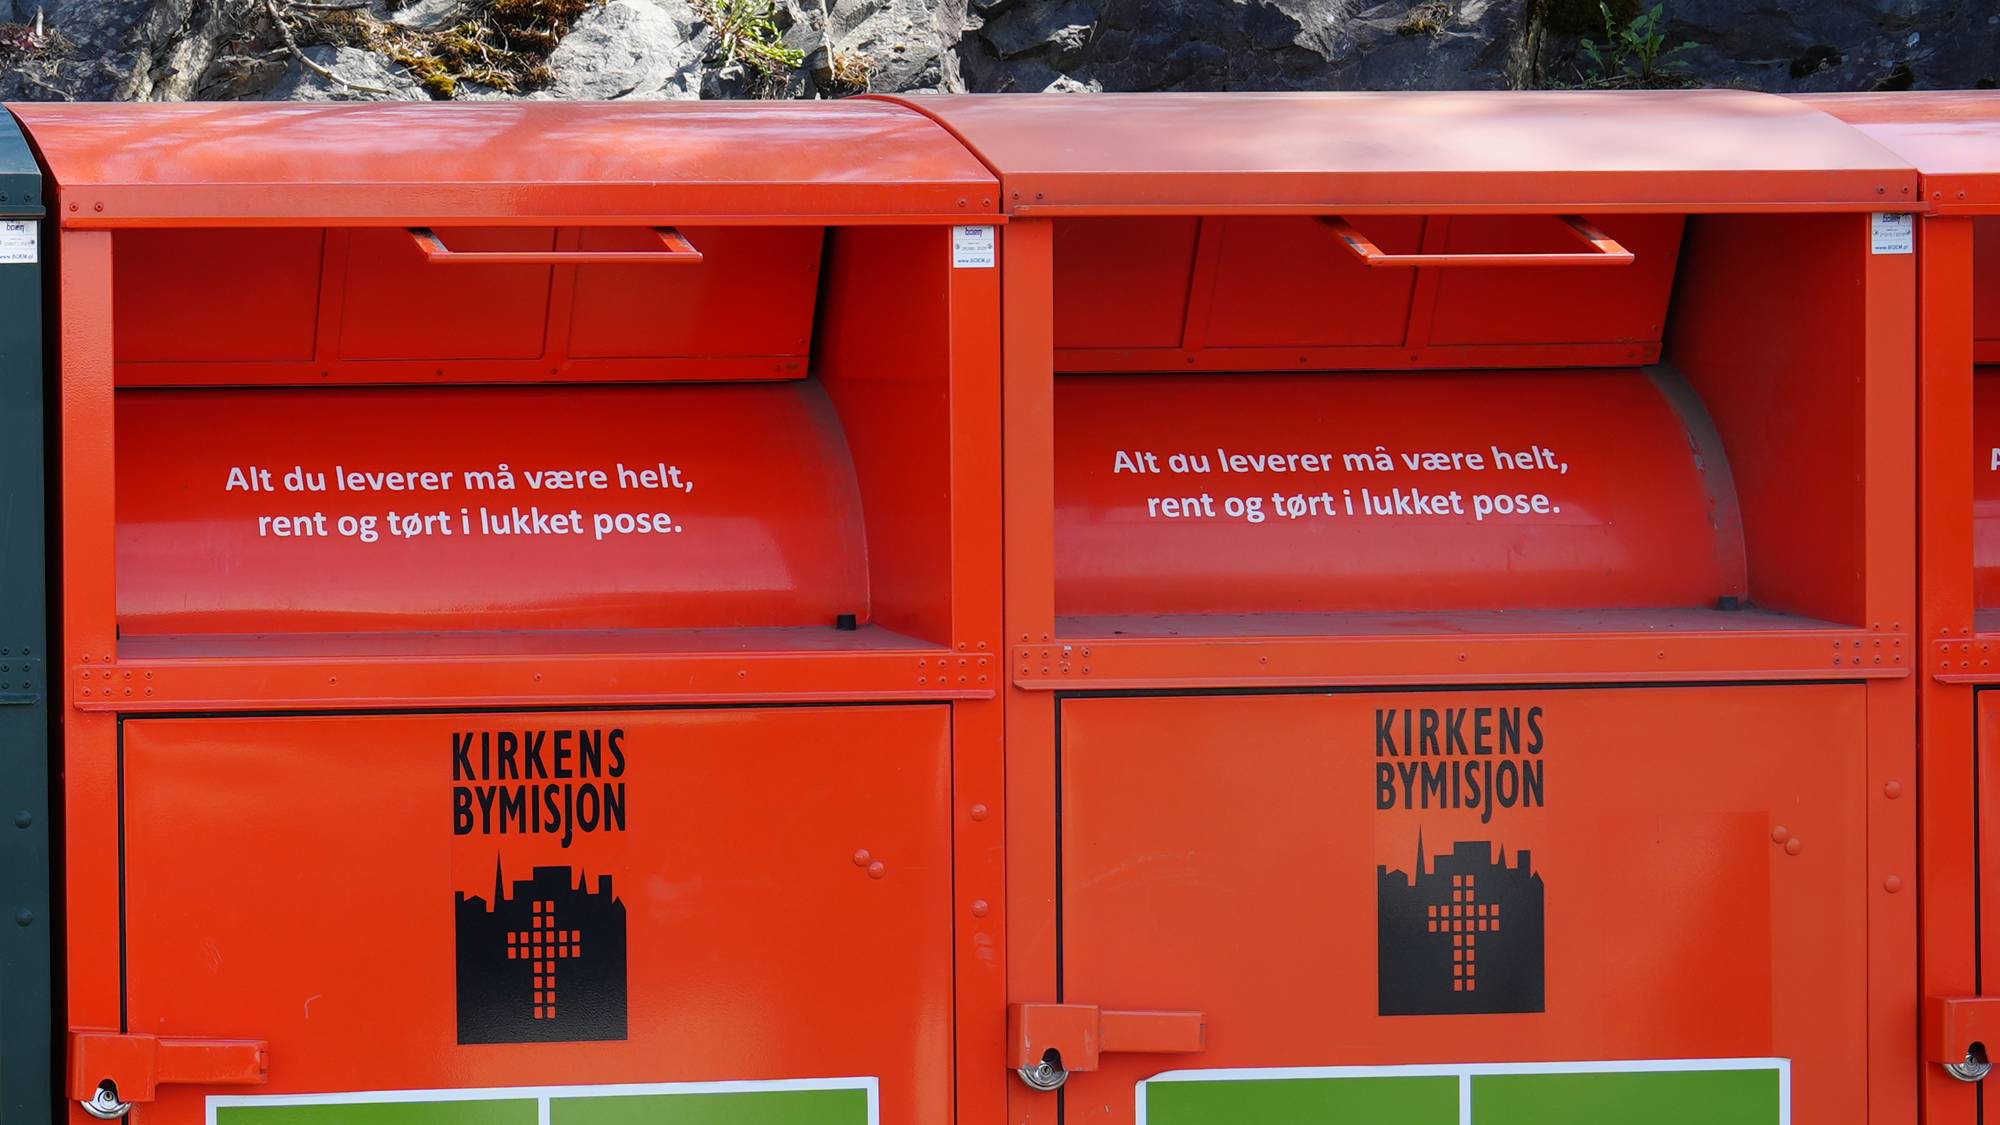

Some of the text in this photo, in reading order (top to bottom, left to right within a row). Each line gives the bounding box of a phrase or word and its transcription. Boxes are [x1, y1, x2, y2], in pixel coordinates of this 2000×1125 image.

[225, 463, 693, 492] Alt du leverer må være helt,
[1114, 445, 1568, 473] Alt du leverer må være helt,
[258, 506, 683, 543] rent og tørt i lukket pose.
[1147, 488, 1561, 524] rent og tørt i lukket pose.
[1376, 707, 1544, 757] KIRKENS
[453, 729, 626, 781] KIRKENS
[1377, 760, 1544, 824] BYMISJON
[454, 783, 626, 849] BYMISJON
